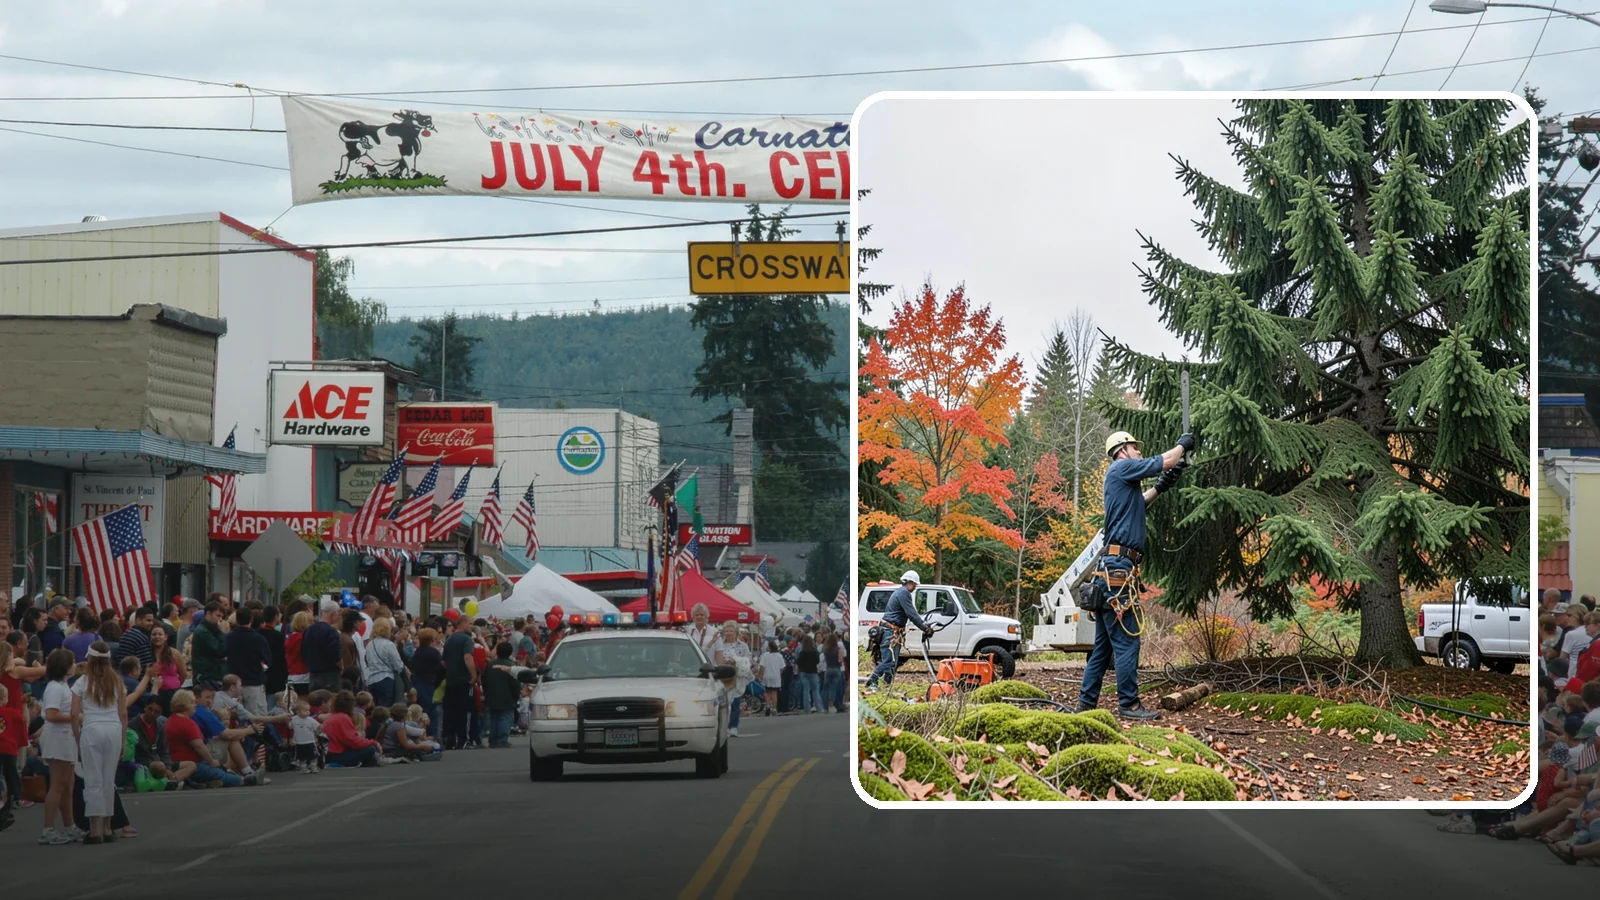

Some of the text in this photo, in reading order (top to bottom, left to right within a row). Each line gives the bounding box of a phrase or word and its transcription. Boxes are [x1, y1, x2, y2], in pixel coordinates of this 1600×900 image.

[695, 121, 850, 150] Carnat
[481, 141, 604, 193] JULY
[632, 150, 746, 198] 4th.
[697, 254, 850, 281] CROSSWA
[282, 380, 373, 420] ACE
[405, 409, 452, 422] CEDAR
[283, 421, 370, 436] Hardware
[95, 485, 124, 494] Vincent
[125, 485, 136, 494] de
[137, 486, 155, 496] Paul
[212, 516, 331, 535] HARDARE
[688, 526, 741, 535] CRNATION
[699, 535, 730, 543] GLASS
